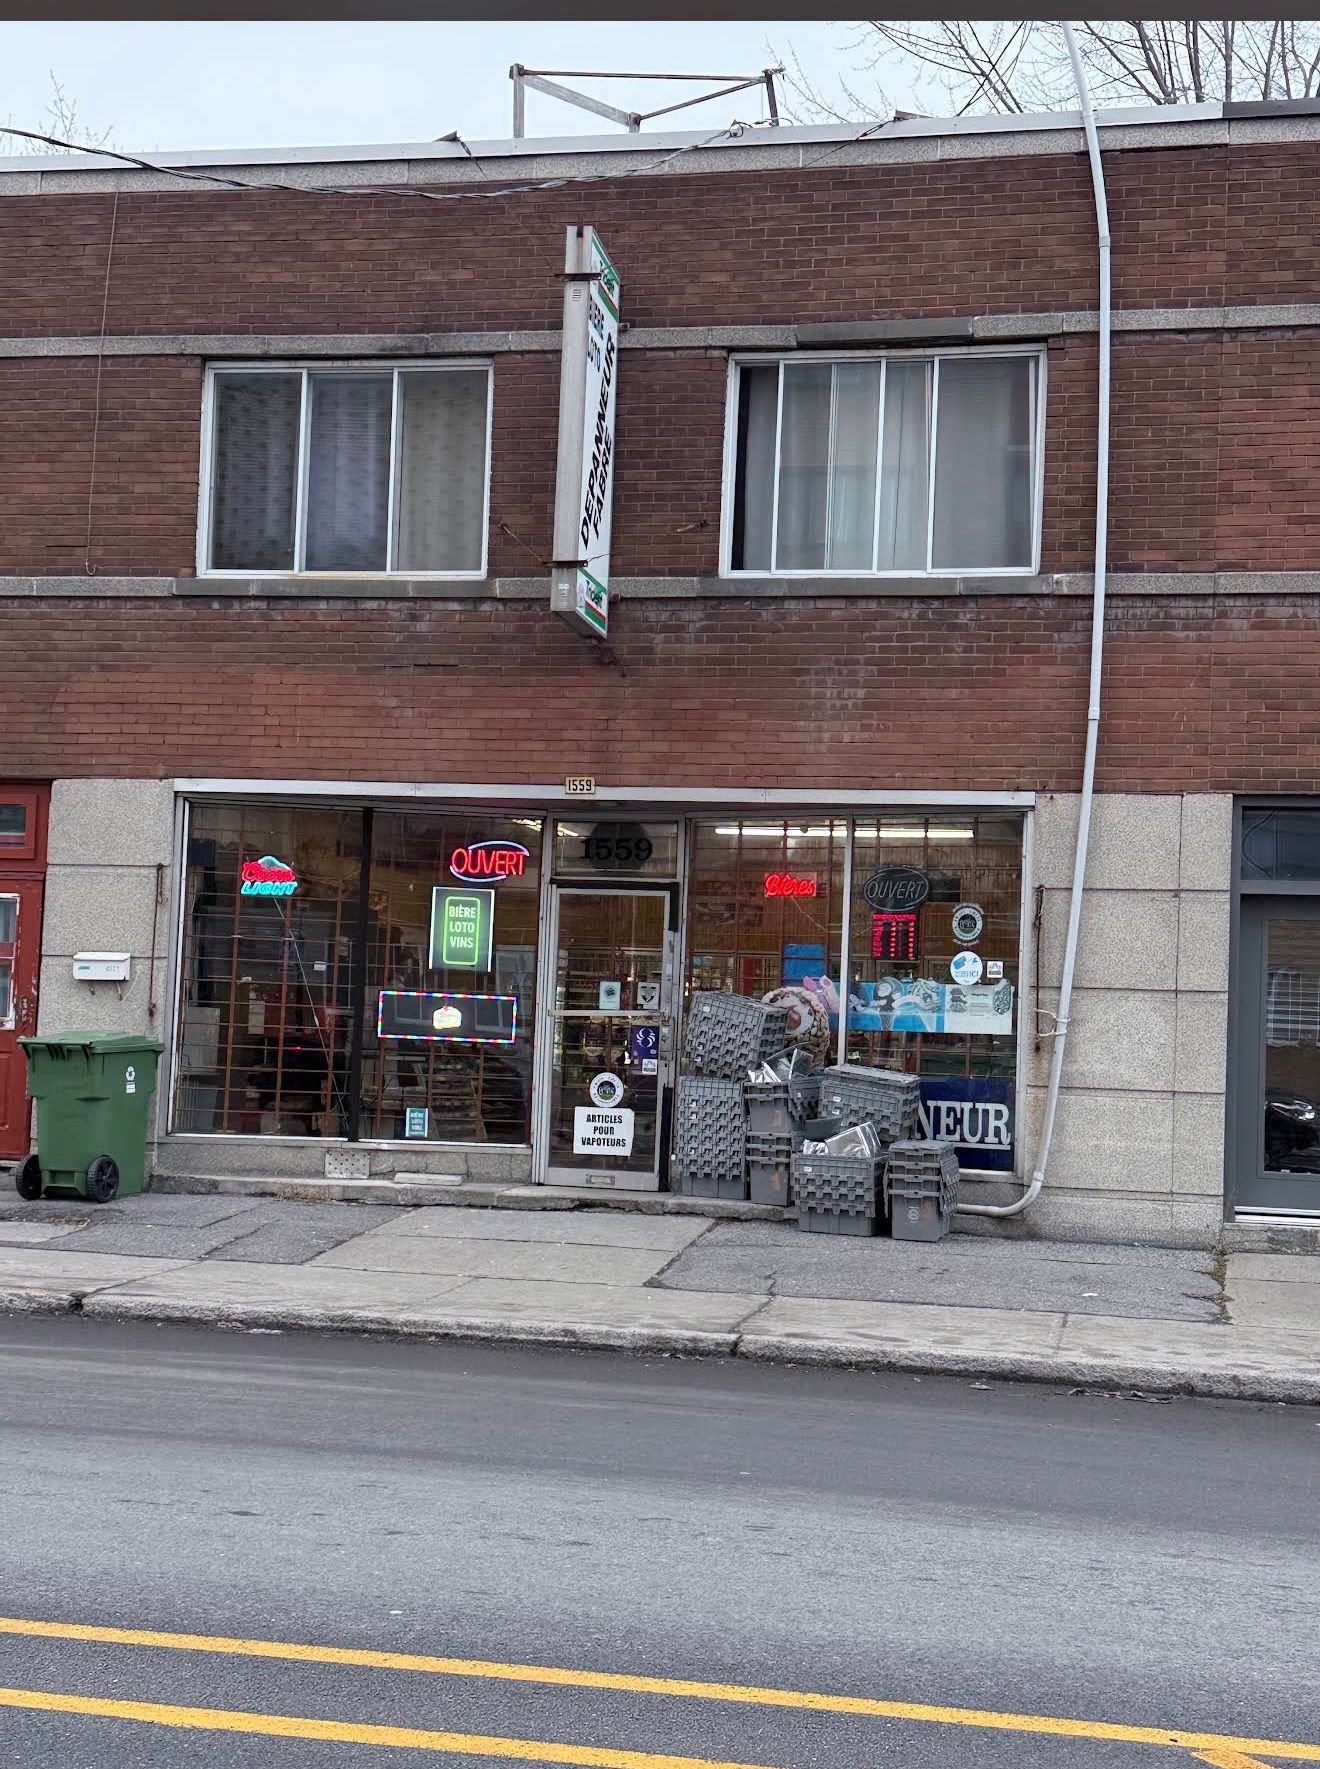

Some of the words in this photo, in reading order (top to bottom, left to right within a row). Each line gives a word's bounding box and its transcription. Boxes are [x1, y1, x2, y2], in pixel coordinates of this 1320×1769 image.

[580, 332, 615, 550] DEPANNEUR
[593, 425, 611, 540] FABRE
[568, 779, 592, 791] 1559
[581, 838, 653, 861] 1559
[451, 848, 526, 875] OUVERT
[241, 881, 298, 895] LIGHT
[867, 881, 924, 898] OUVERT
[449, 904, 476, 918] BIÈRE
[449, 922, 475, 933] LOTO
[450, 937, 473, 948] VINS
[586, 1114, 623, 1124] ARTICLES
[593, 1126, 615, 1135] POUR
[581, 1136, 627, 1147] VAPOTEURS
